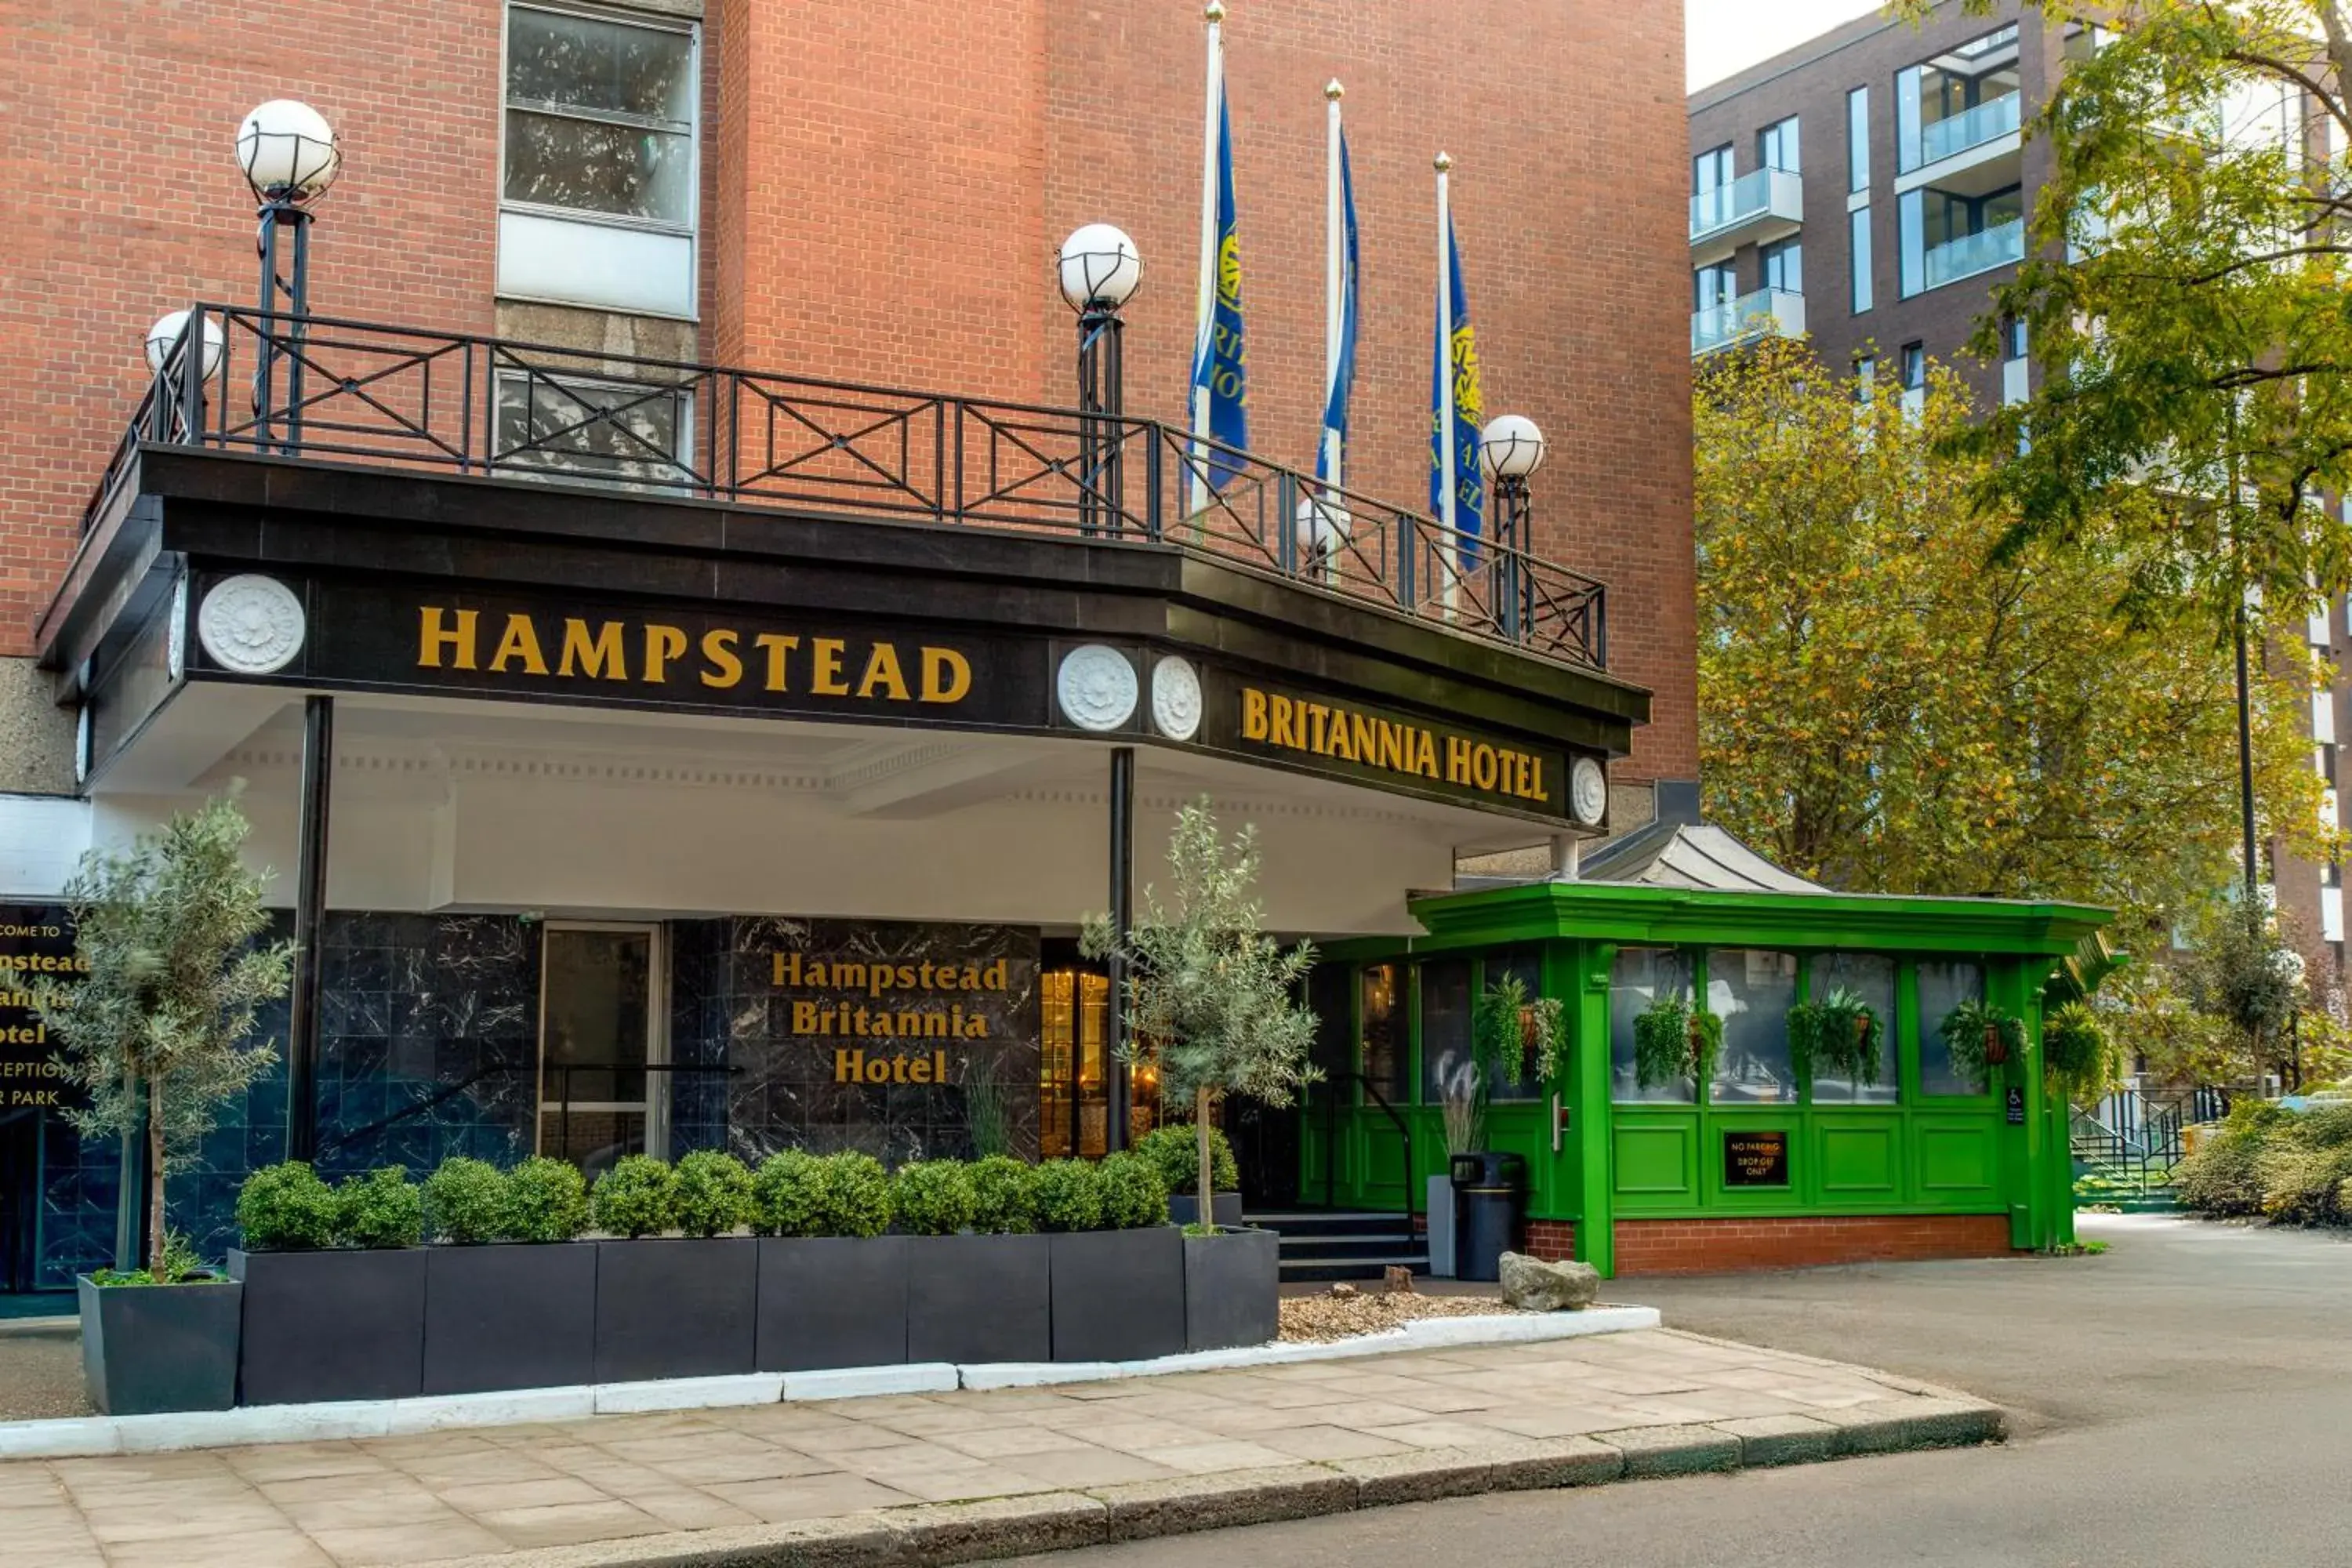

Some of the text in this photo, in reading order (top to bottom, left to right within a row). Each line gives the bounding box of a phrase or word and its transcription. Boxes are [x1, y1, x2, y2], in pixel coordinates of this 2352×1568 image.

[417, 606, 973, 703] HAMPSTEAD
[1242, 688, 1548, 801] BRITANNIA HOTEL
[41, 926, 60, 937] TO
[772, 953, 1008, 998] Hampstead
[793, 1001, 989, 1038] Britannia
[834, 1049, 947, 1083] Hotel
[12, 1091, 60, 1105] PARK
[1731, 1142, 1744, 1152] NO
